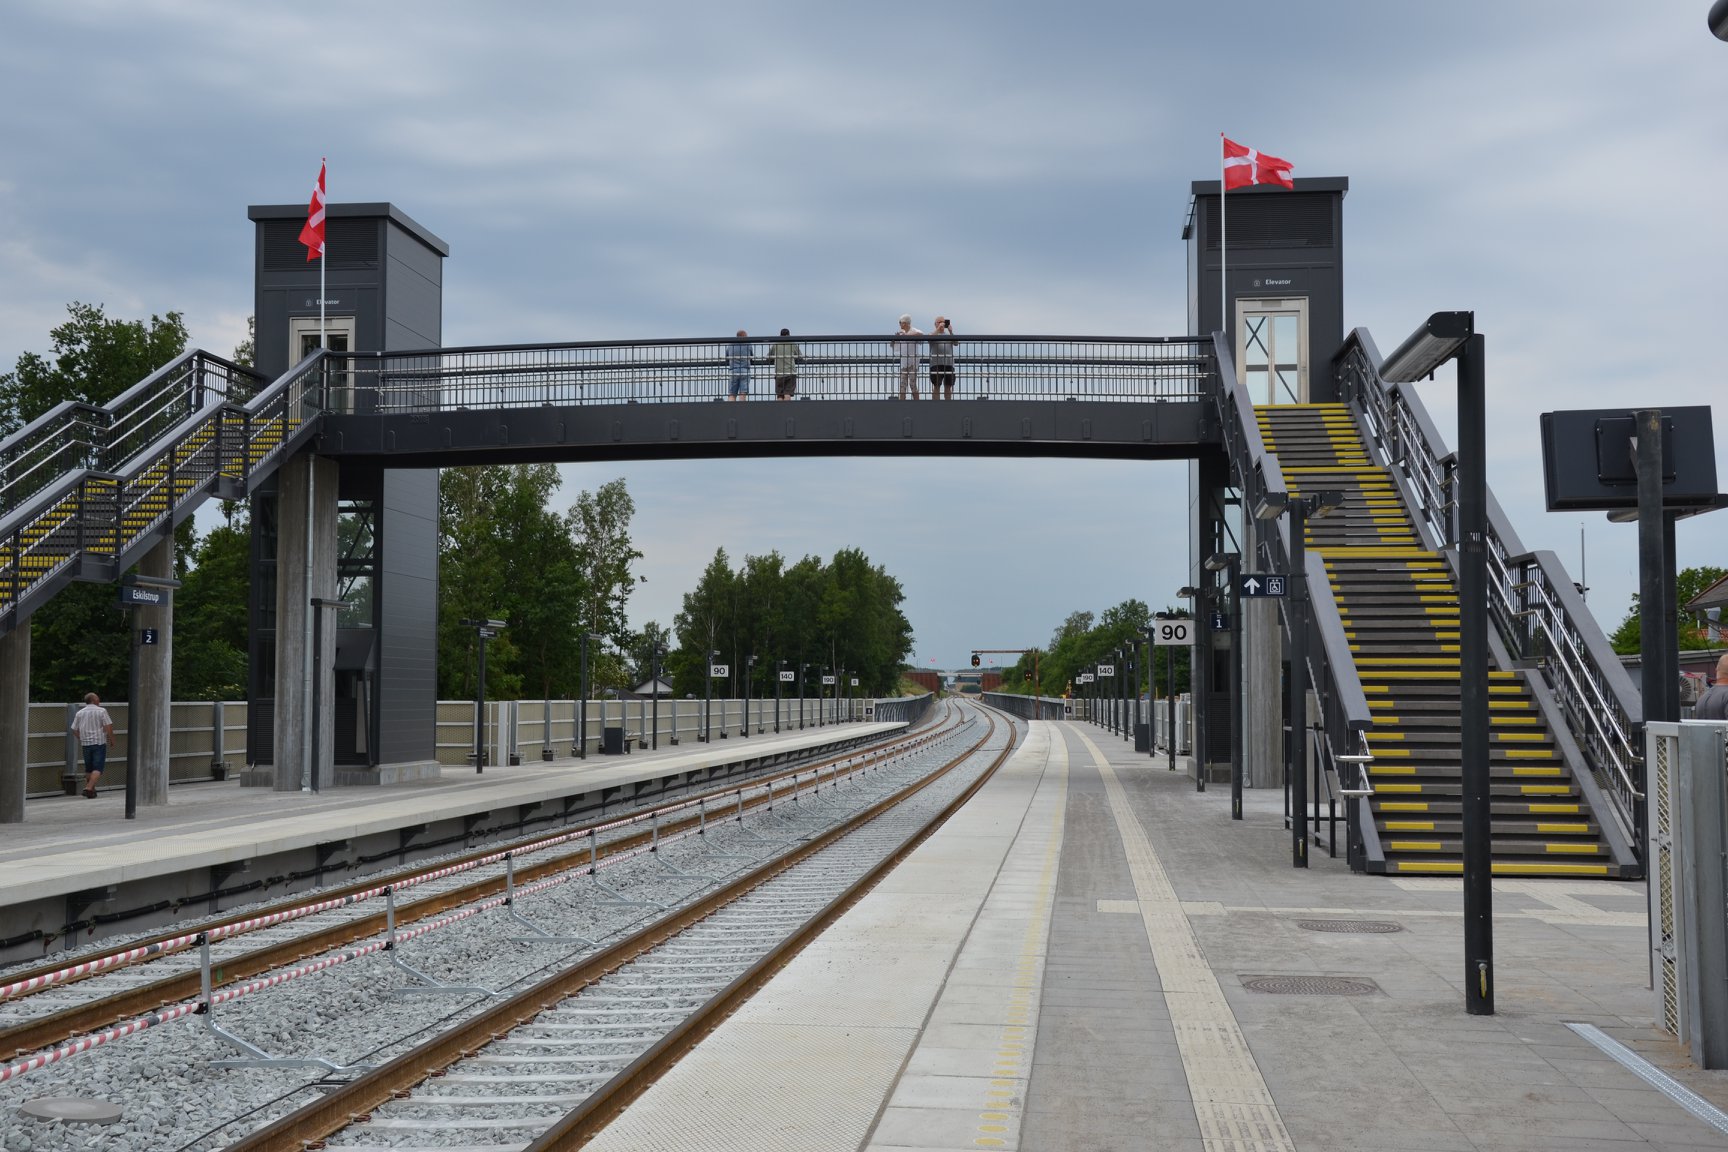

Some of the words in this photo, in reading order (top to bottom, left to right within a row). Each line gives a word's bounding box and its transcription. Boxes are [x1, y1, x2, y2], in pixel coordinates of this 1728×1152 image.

[132, 590, 160, 603] Eskilstrup
[1216, 619, 1223, 628] 1
[1161, 625, 1187, 640] 90
[145, 634, 152, 643] 2
[713, 667, 726, 675] 90
[1100, 667, 1112, 675] 140
